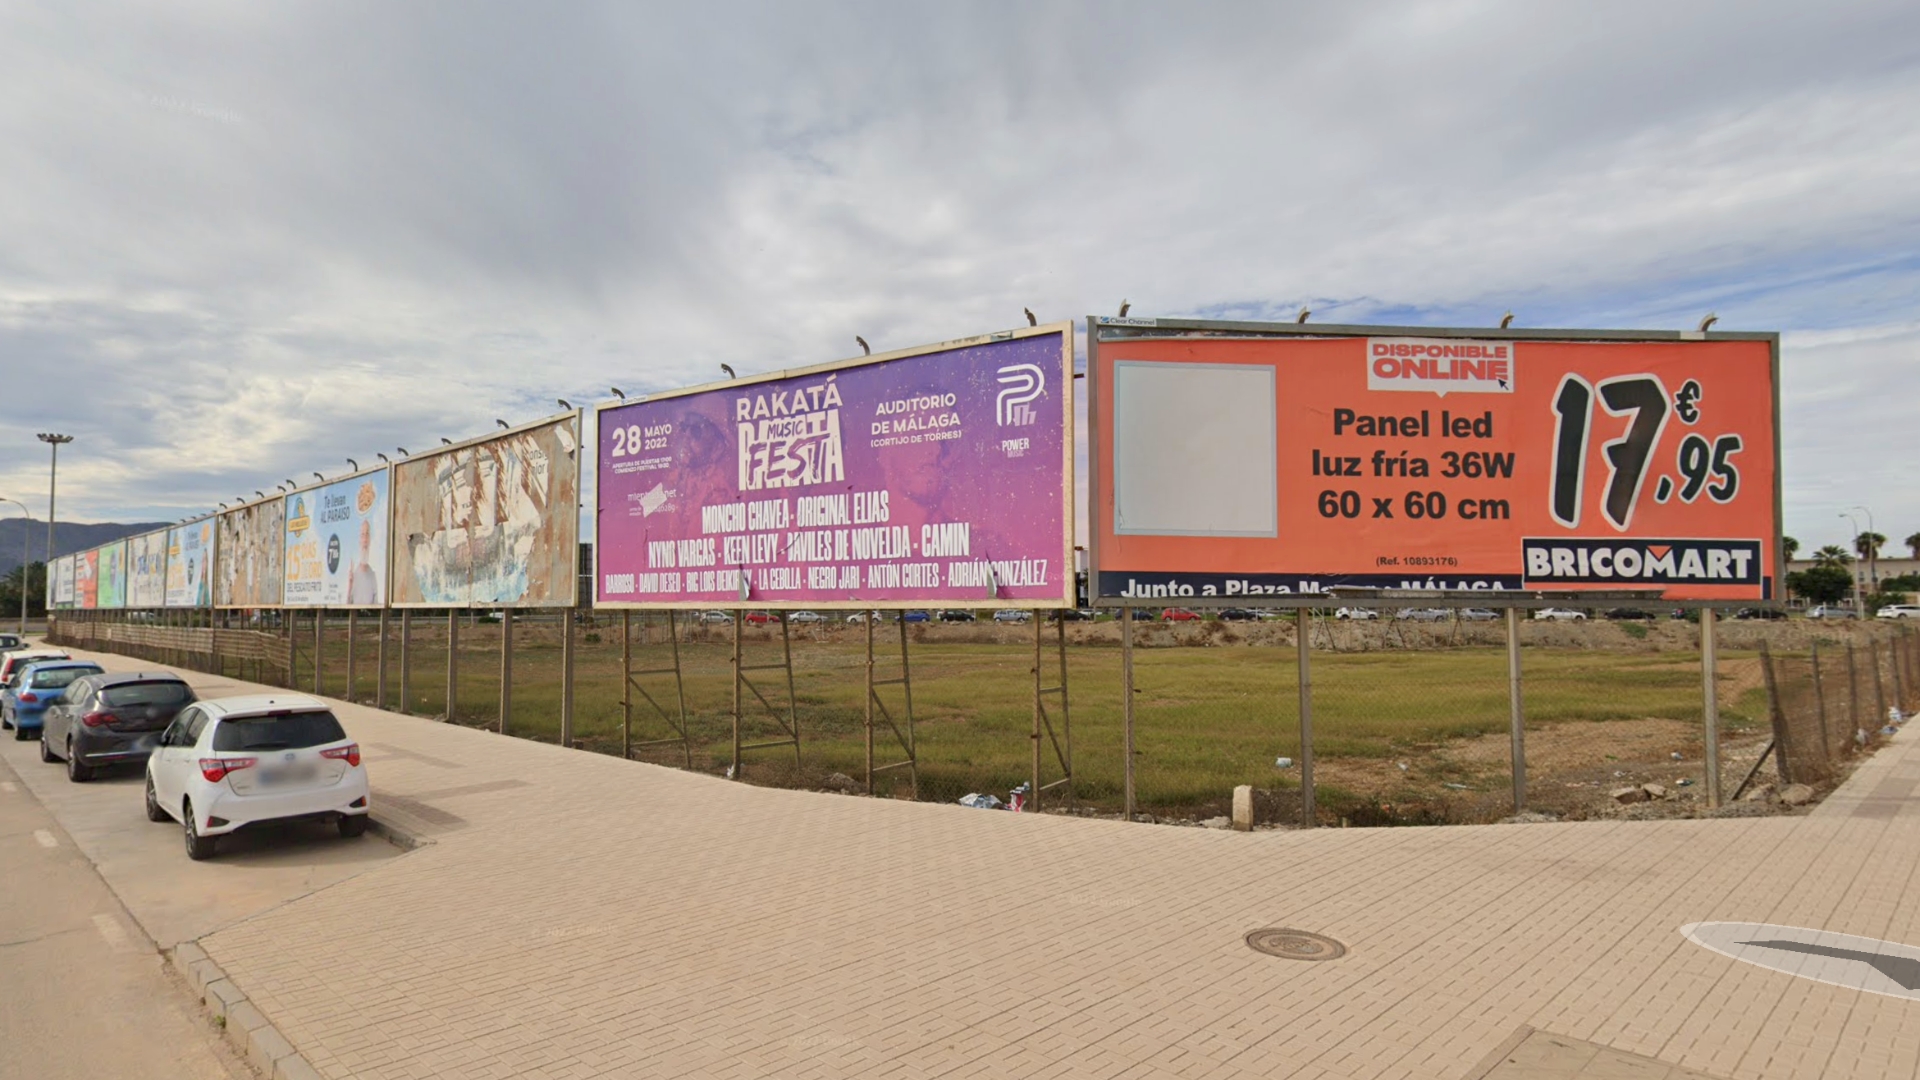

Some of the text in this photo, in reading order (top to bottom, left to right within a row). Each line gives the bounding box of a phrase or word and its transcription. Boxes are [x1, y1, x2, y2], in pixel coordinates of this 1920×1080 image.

[1373, 344, 1508, 359] DISPONIBLE
[1373, 357, 1508, 380] ONLINE
[736, 373, 843, 422] RAKATÁ
[875, 393, 956, 416] AUDITORIO
[767, 420, 804, 440] MUSIC
[871, 412, 961, 435] DE MÁLAGA
[1333, 408, 1493, 438] Panel led
[612, 423, 672, 457] 28 MAYO
[644, 437, 668, 450] 2022
[870, 430, 962, 448] (CORTIJO DE TORRES)
[1002, 437, 1030, 451] POWER
[1312, 449, 1515, 478] luz fría 36W
[324, 495, 330, 509] Te
[702, 490, 889, 534] MONCHO CHAVEA ORIGINAL ELIAS
[1318, 489, 1510, 520] 60 x 60 cm
[321, 510, 327, 523] AL
[648, 540, 675, 568] NYNO
[677, 538, 716, 567] VARGAS
[723, 534, 750, 565] KEEN
[752, 533, 779, 564] LEVY
[834, 529, 849, 561] DE
[852, 525, 911, 560] NOVELDA
[921, 522, 970, 558] CAMIN
[1376, 556, 1458, 567] (Ref. 10893176)
[1526, 547, 1752, 579] BRICOMART
[605, 573, 635, 594] BARROSO
[639, 573, 659, 593] DAVID
[659, 572, 681, 593] DESEO
[686, 571, 699, 592] BIG
[758, 568, 769, 590] LA
[770, 566, 801, 590] CEBOLLA
[808, 566, 837, 589] NEGRO
[838, 565, 860, 589] JARI
[867, 560, 900, 589] ANTÓN
[902, 562, 939, 588] CORTES
[948, 557, 988, 588] ADRIÁN
[1120, 579, 1194, 598] Junto
[1202, 583, 1217, 597] a
[1225, 580, 1291, 595] Plaza
